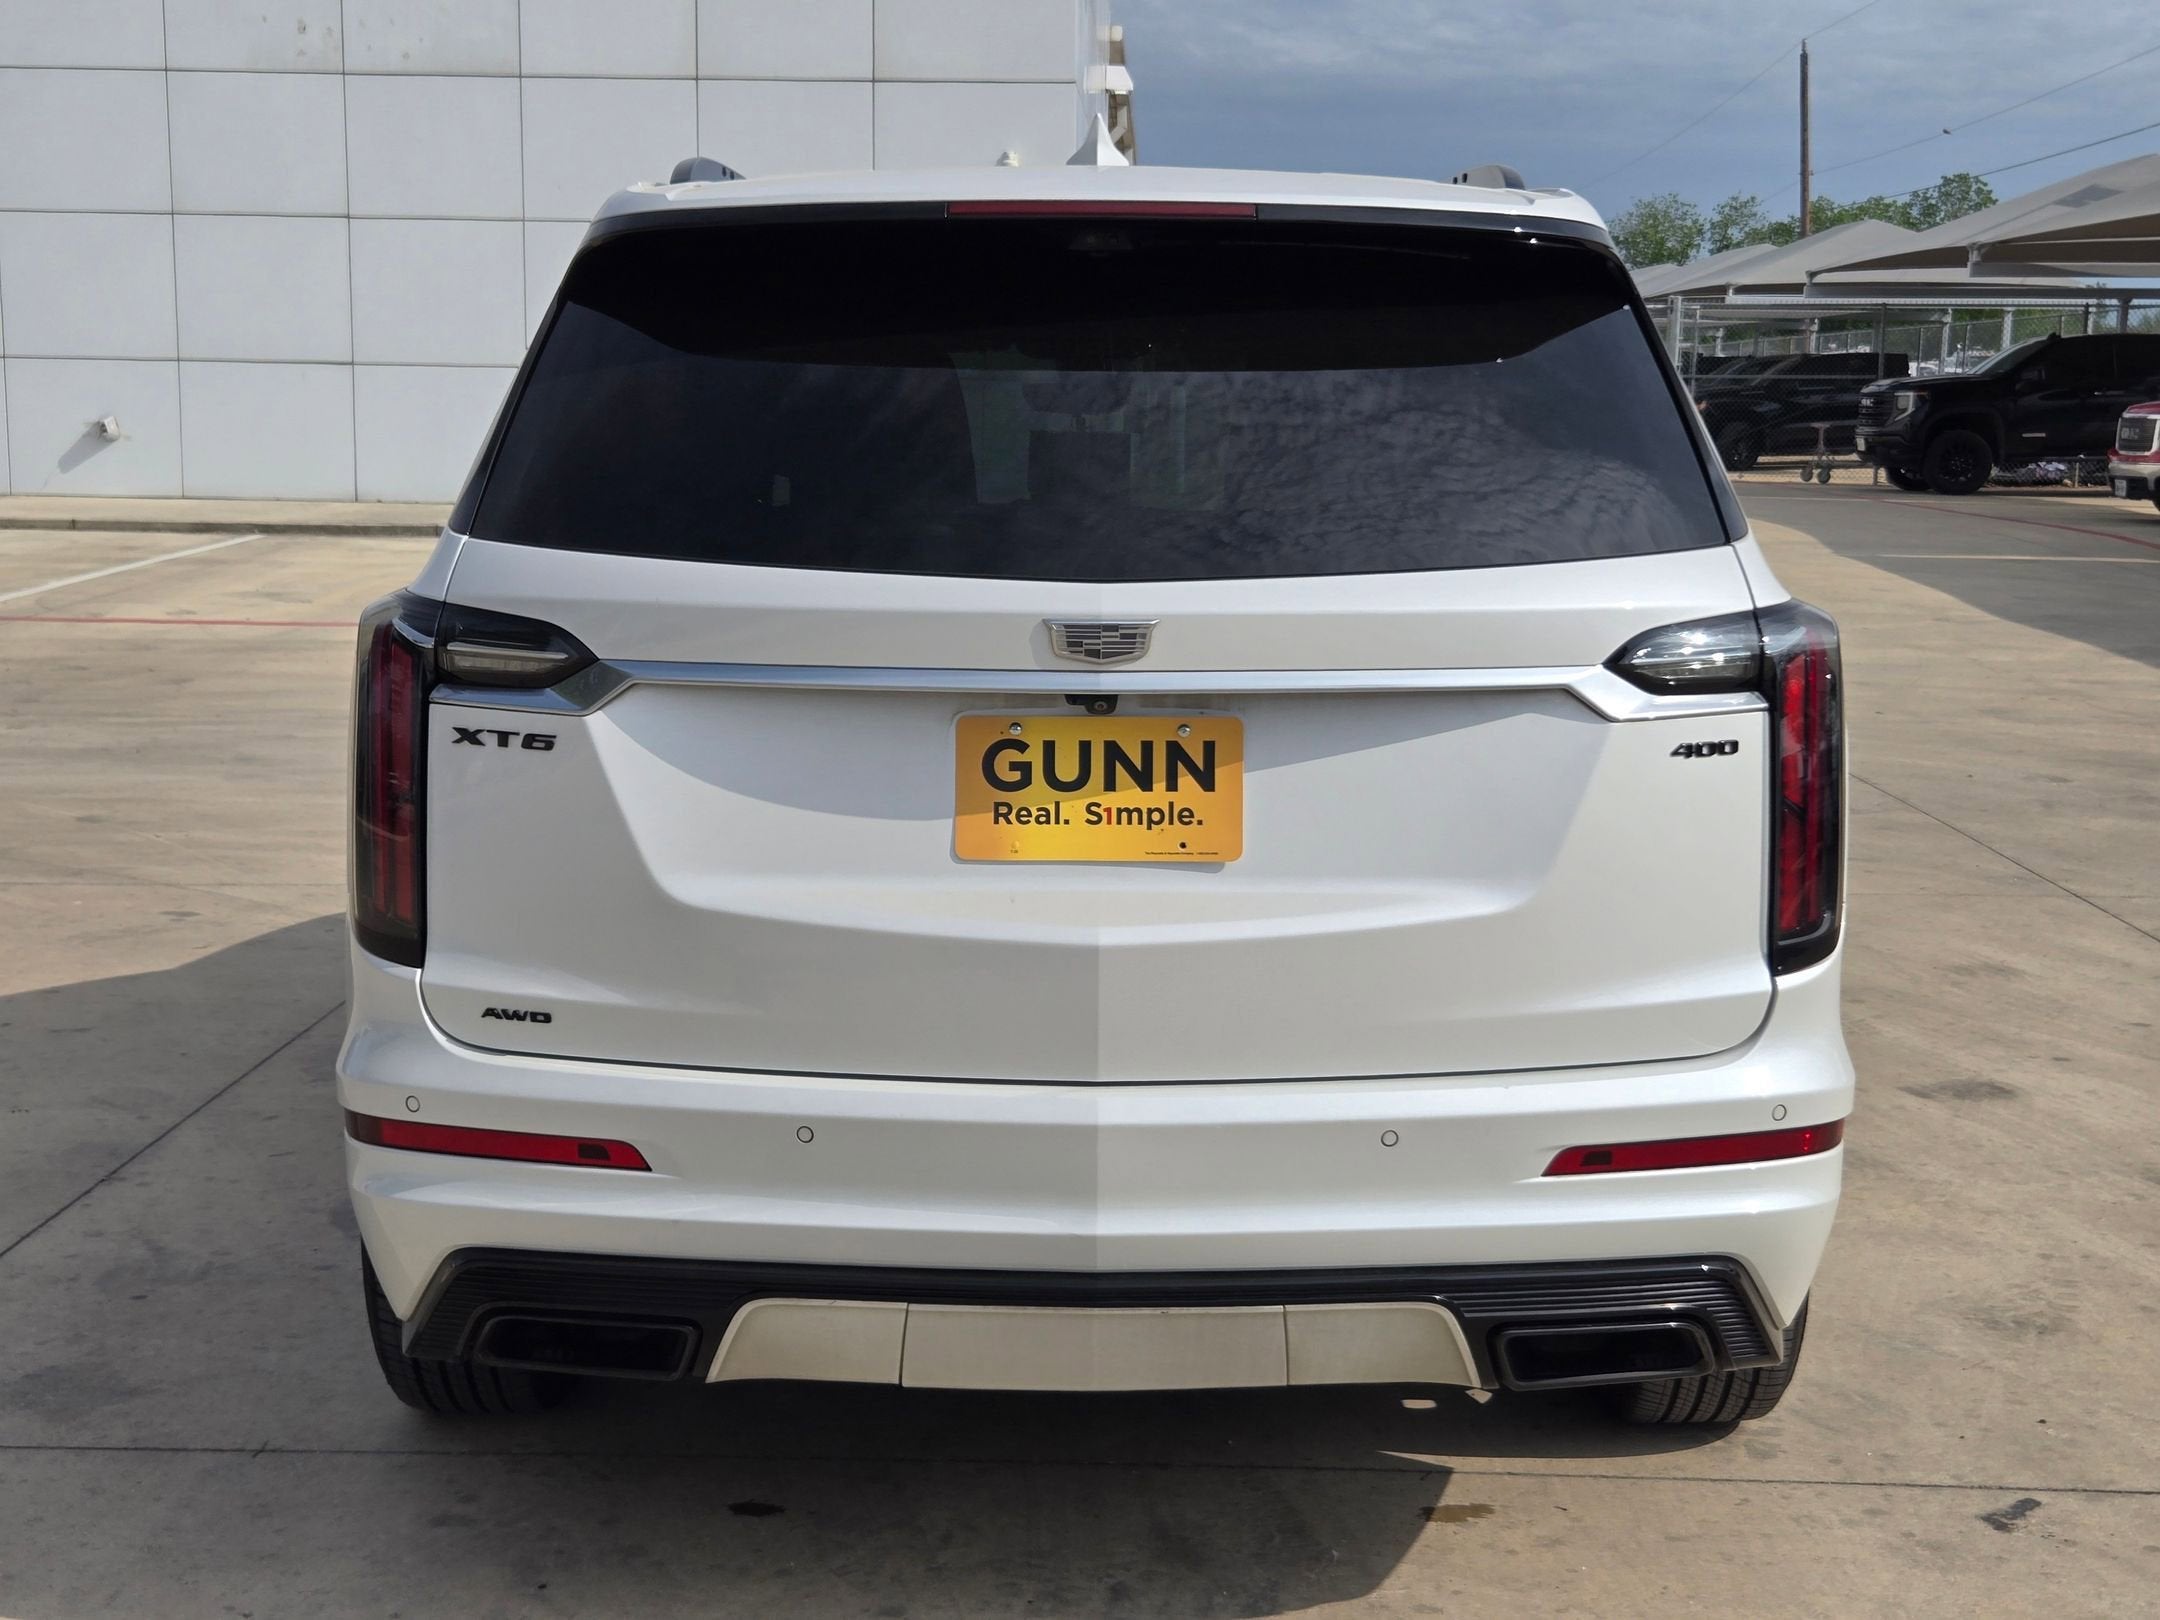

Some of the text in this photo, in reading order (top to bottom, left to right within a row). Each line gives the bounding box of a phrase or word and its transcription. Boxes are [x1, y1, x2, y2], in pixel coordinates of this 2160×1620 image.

[451, 726, 557, 751] XT6
[1669, 739, 1739, 759] 400
[981, 738, 1216, 793] GUNN
[993, 801, 1070, 825] Real.
[481, 1007, 552, 1024] AWD
